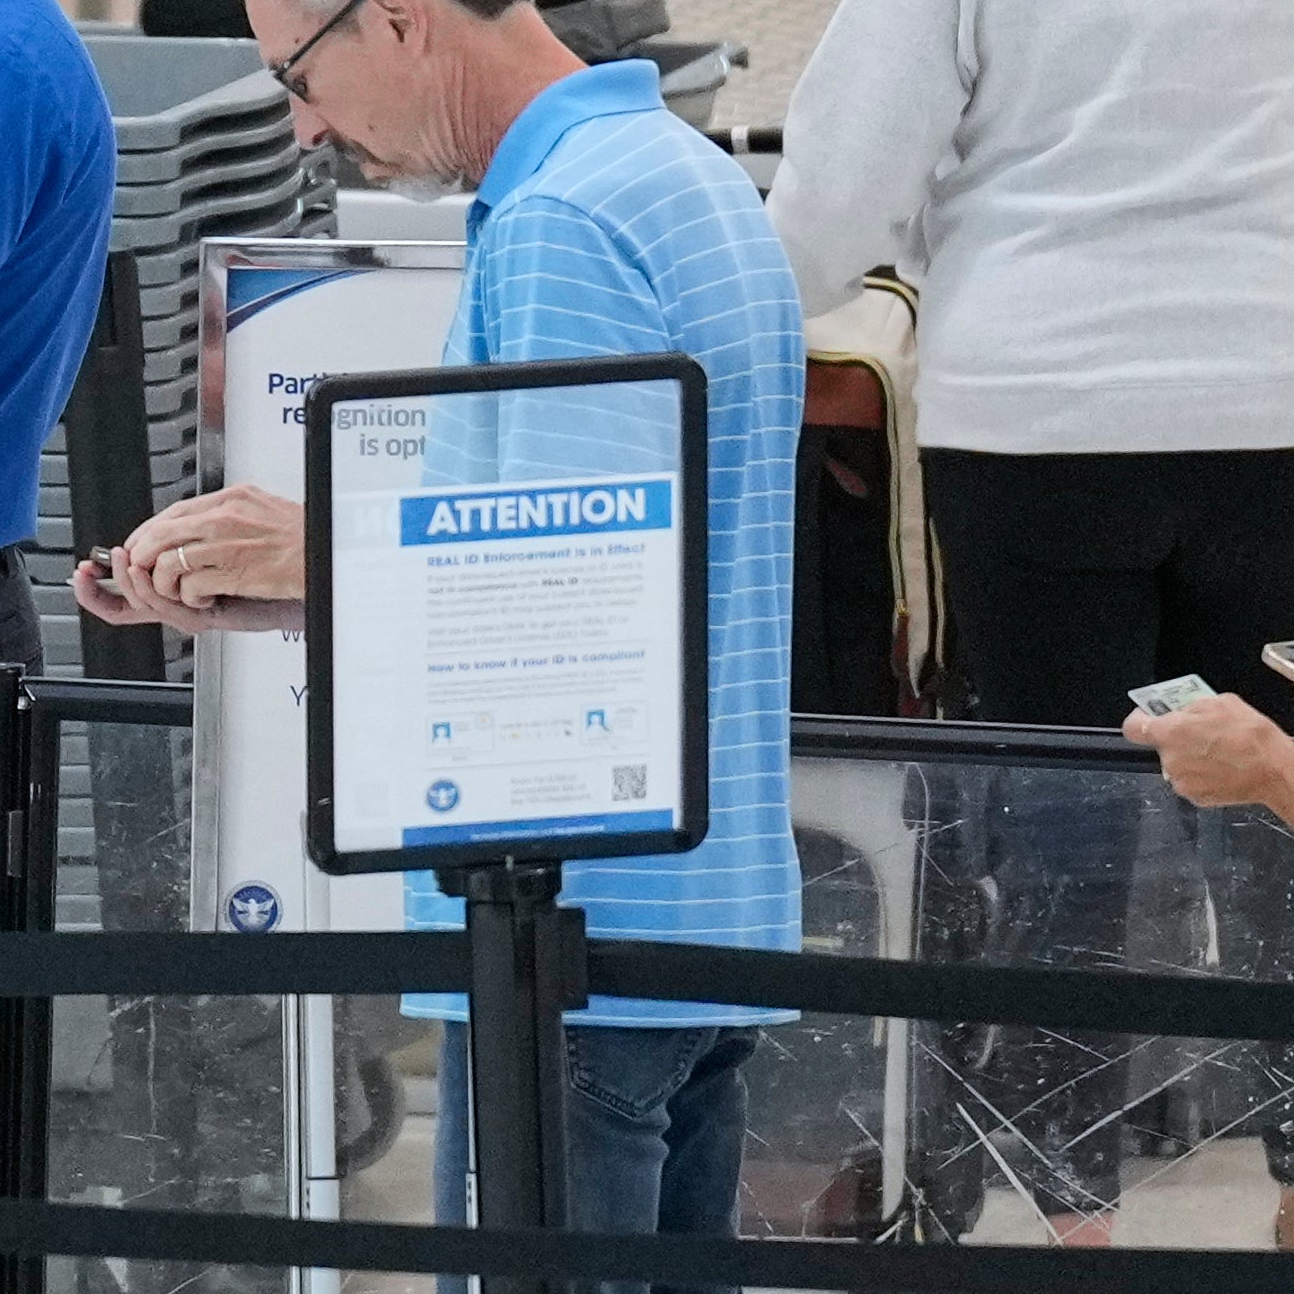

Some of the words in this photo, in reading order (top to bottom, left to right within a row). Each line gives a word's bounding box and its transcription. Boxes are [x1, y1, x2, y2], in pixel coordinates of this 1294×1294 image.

[282, 404, 426, 431] regnition
[359, 434, 379, 456] is
[426, 488, 647, 537] ATTENTION
[427, 556, 460, 568] REAL
[465, 554, 479, 565] ID
[484, 547, 571, 564] Enforcement
[474, 659, 506, 671] know
[522, 657, 549, 670] your
